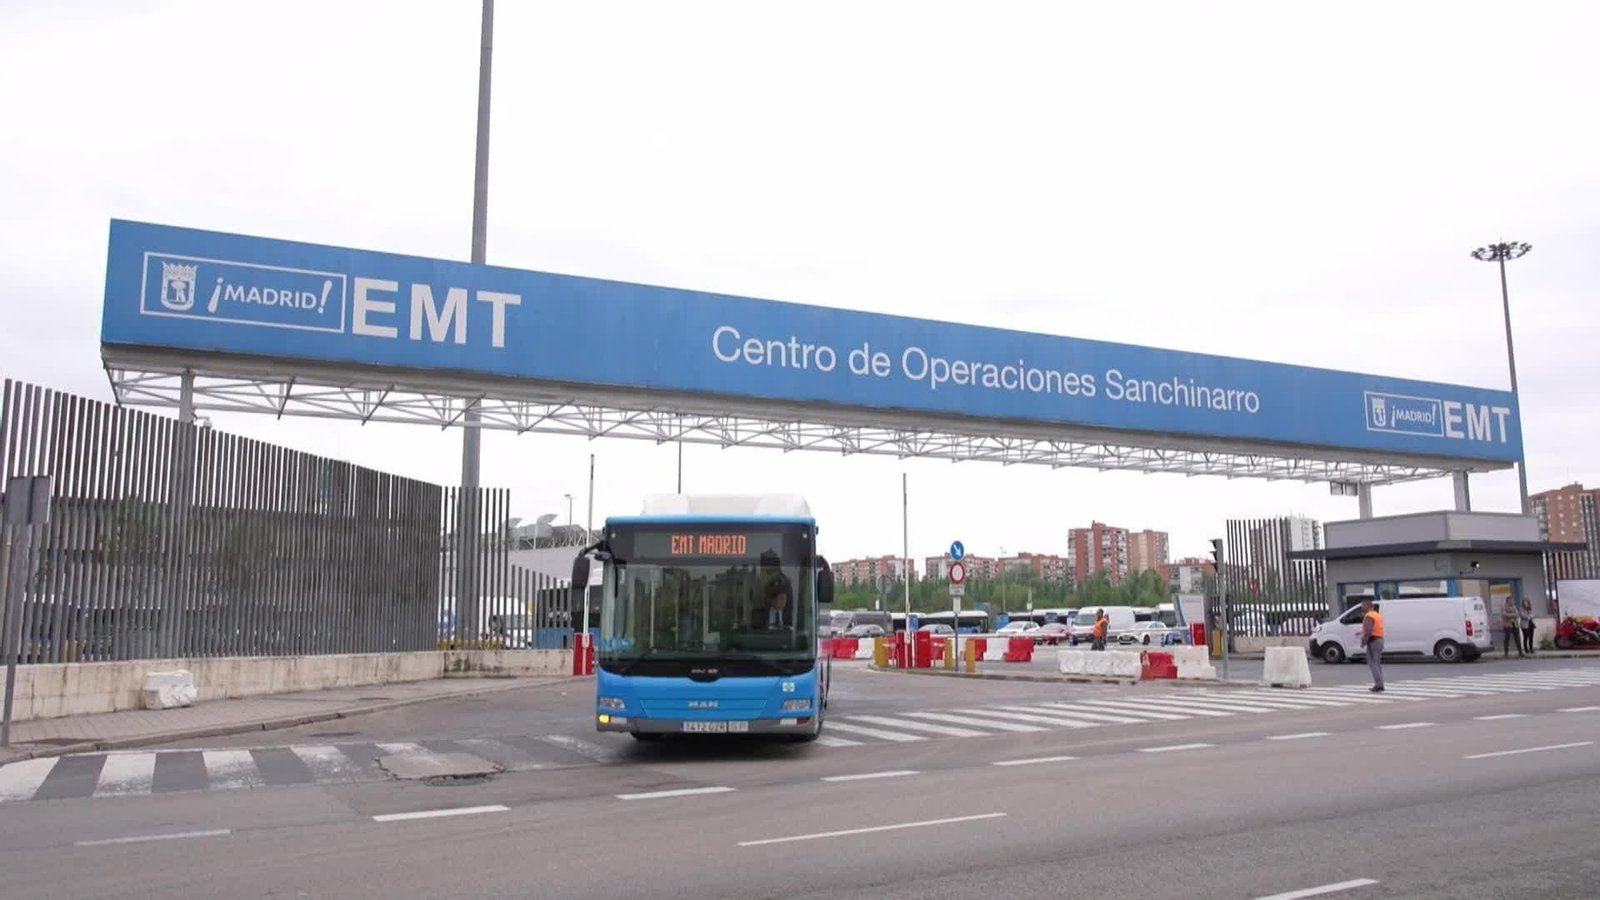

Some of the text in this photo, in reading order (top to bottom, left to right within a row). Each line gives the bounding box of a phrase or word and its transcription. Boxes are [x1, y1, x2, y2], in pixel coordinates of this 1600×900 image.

[352, 277, 521, 348] EMT
[712, 326, 1260, 413] Centro de Operaciones Sanchinarro
[1443, 400, 1510, 443] EMT
[671, 535, 746, 554] EMT MADRID
